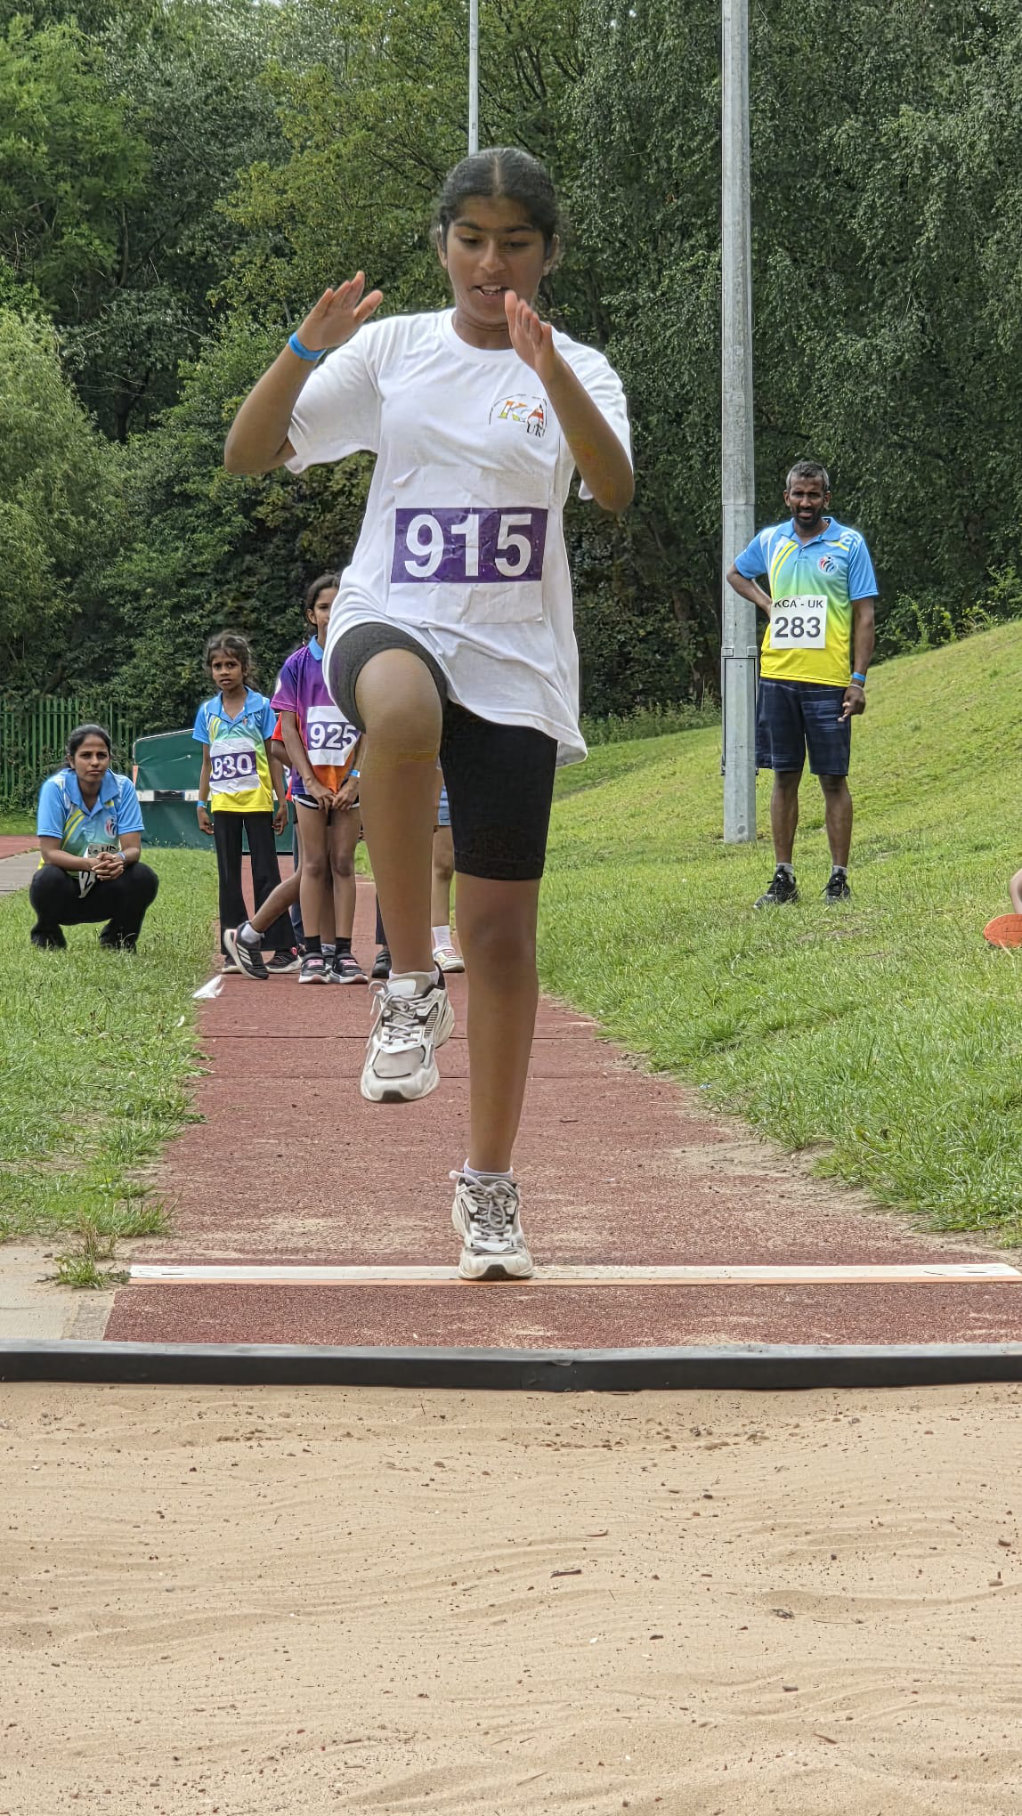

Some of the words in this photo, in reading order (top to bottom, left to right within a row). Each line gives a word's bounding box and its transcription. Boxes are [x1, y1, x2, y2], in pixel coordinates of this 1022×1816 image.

[404, 513, 532, 578] 915
[774, 600, 797, 608] KCA
[808, 600, 823, 608] UK
[774, 616, 821, 638] 283
[310, 723, 357, 750] 925
[212, 753, 253, 780] 930
